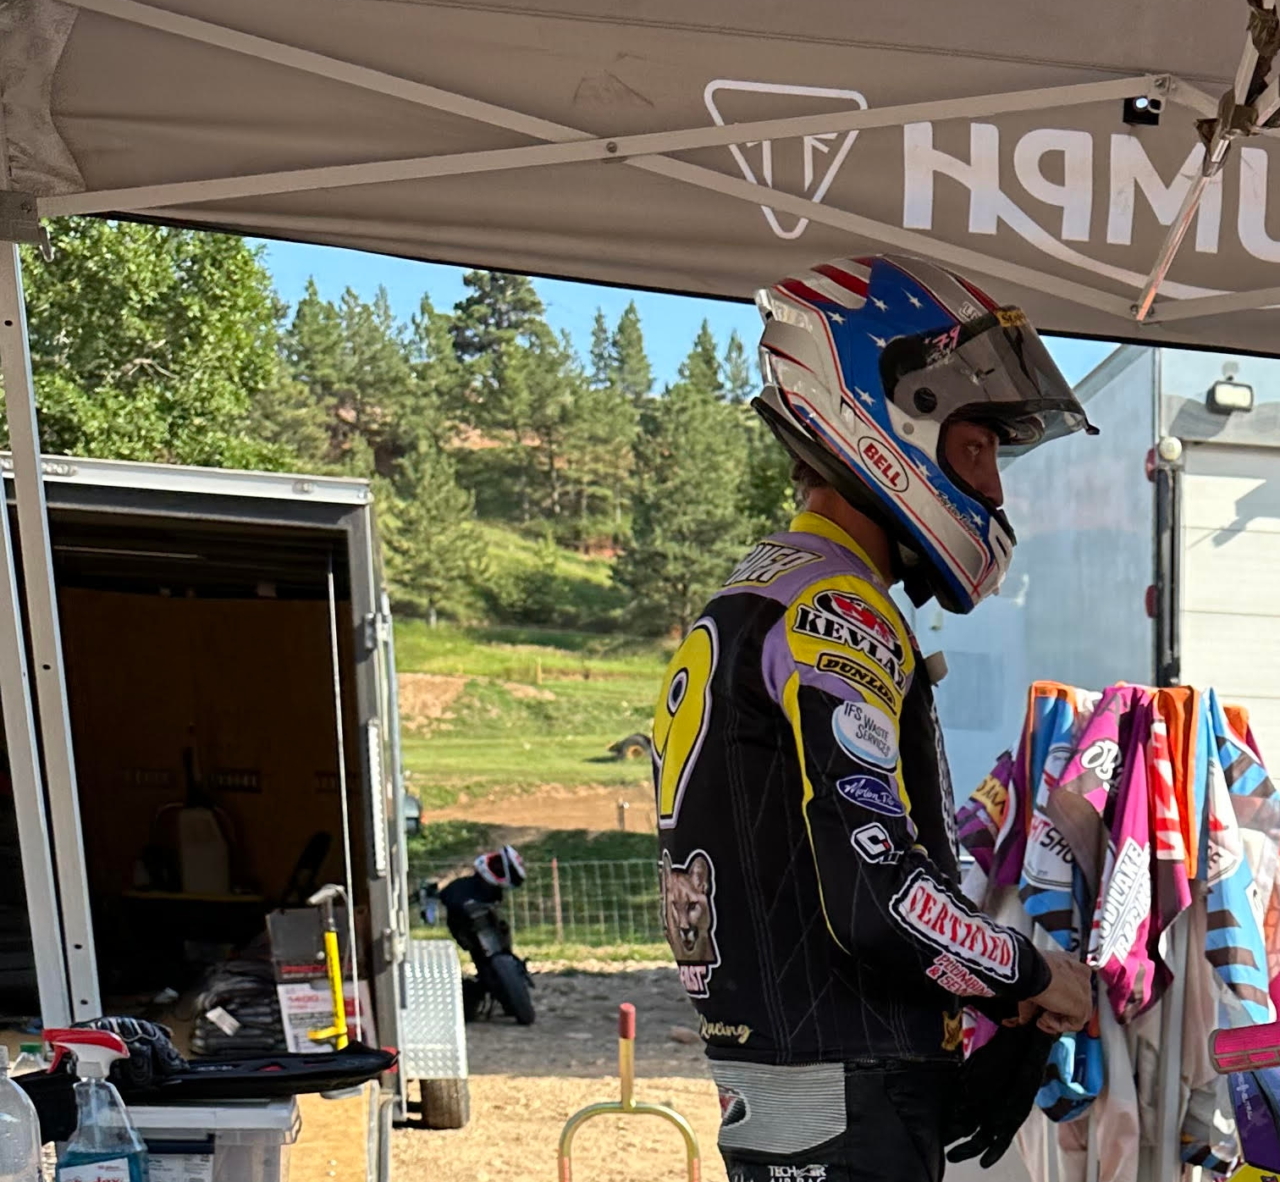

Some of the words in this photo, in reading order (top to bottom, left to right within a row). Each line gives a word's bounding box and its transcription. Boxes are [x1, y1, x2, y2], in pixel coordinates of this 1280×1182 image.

[863, 443, 901, 487] BELL
[844, 703, 862, 720] IFS
[909, 885, 1011, 967] CERTIFIED
[701, 1014, 752, 1044] Racing
